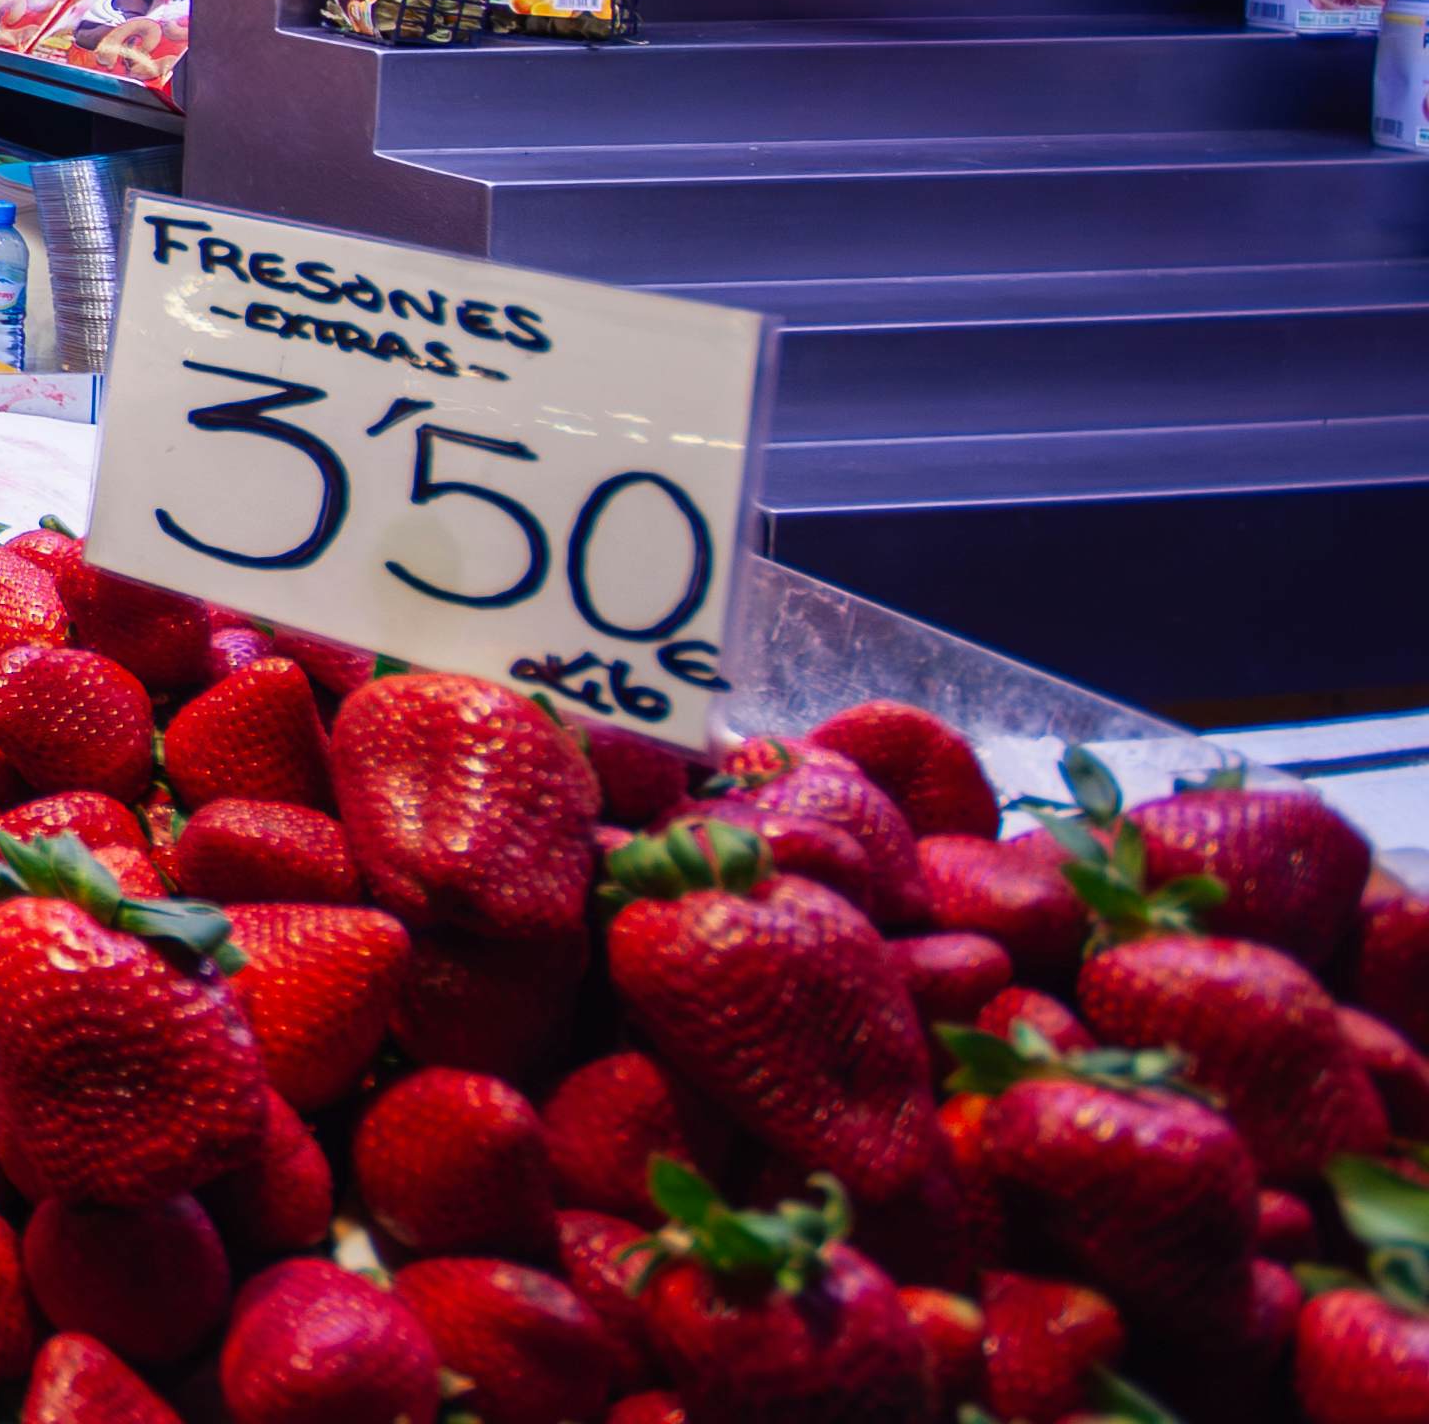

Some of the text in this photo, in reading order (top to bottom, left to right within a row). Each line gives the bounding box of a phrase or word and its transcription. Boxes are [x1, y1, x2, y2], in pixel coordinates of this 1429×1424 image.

[143, 214, 553, 354] FRESONES
[154, 358, 734, 694] 3'50 €
